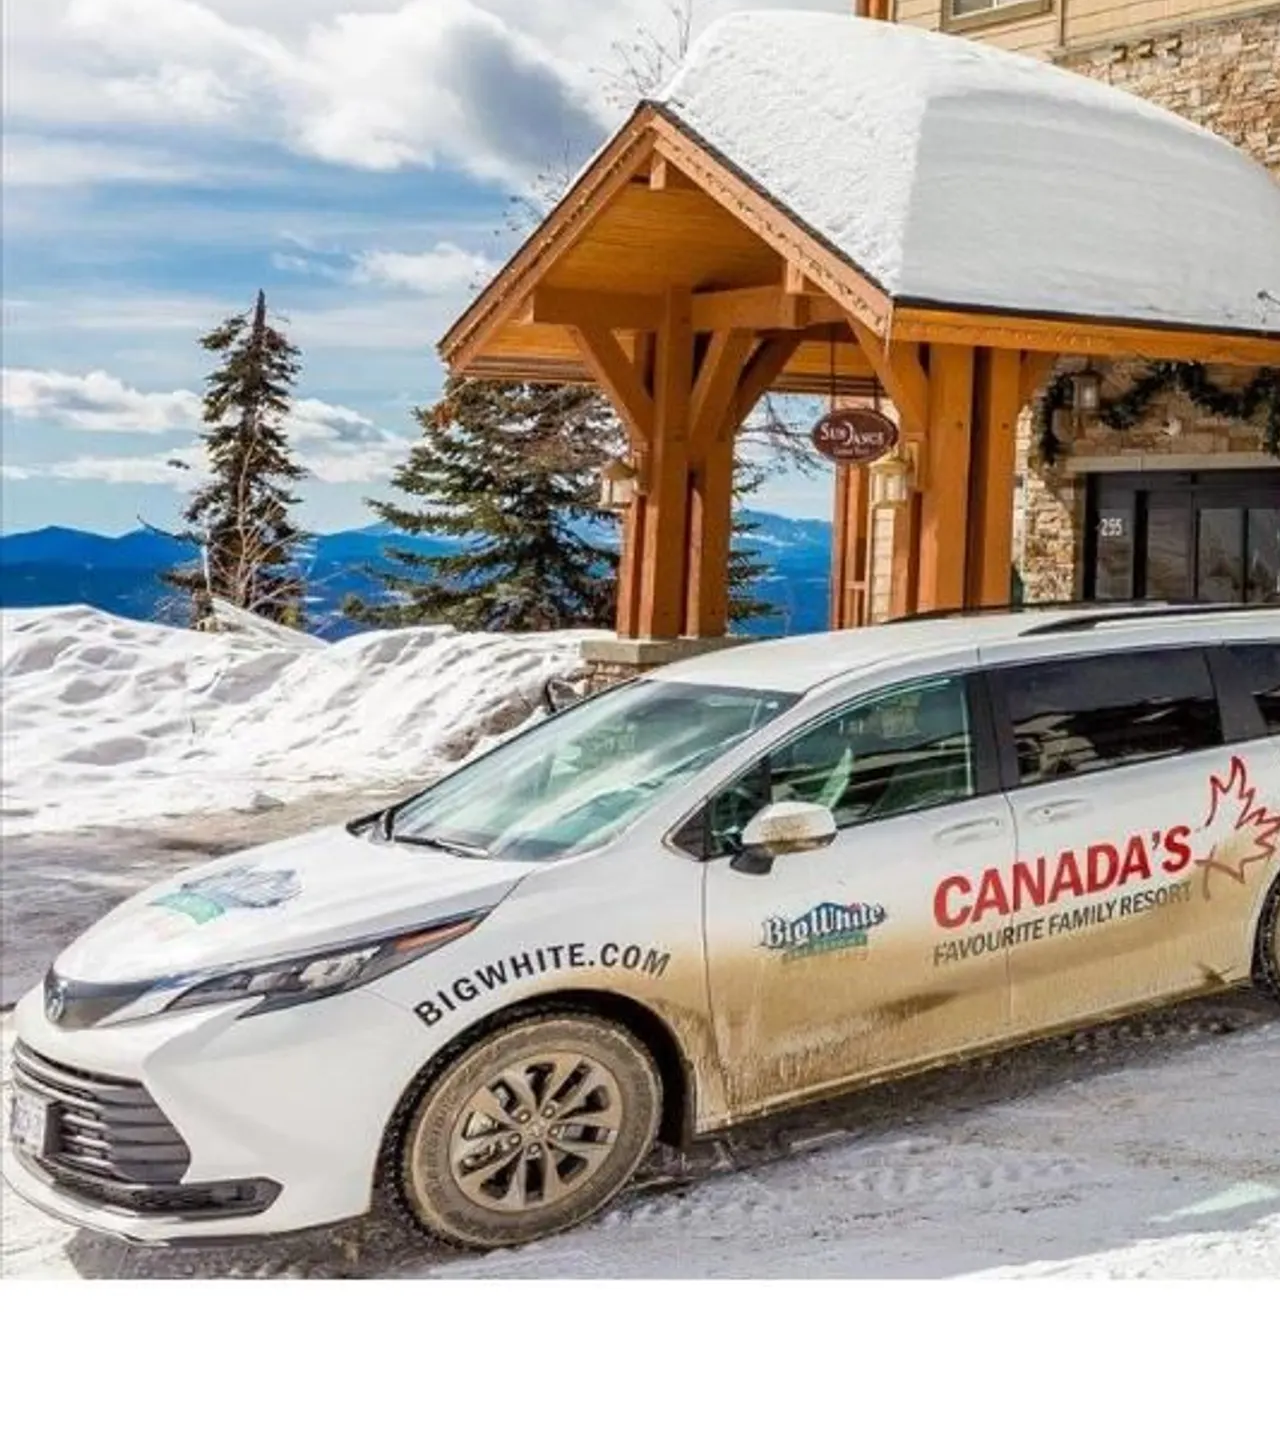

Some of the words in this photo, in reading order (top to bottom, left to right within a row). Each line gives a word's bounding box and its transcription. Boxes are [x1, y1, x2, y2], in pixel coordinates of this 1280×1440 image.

[934, 825, 1192, 929] CANADA'S
[933, 919, 1044, 966] FAVOURITE
[1049, 900, 1116, 935] FAMILY
[1120, 881, 1192, 916] RESORT
[413, 942, 671, 1026] BIGWHITE.COM
